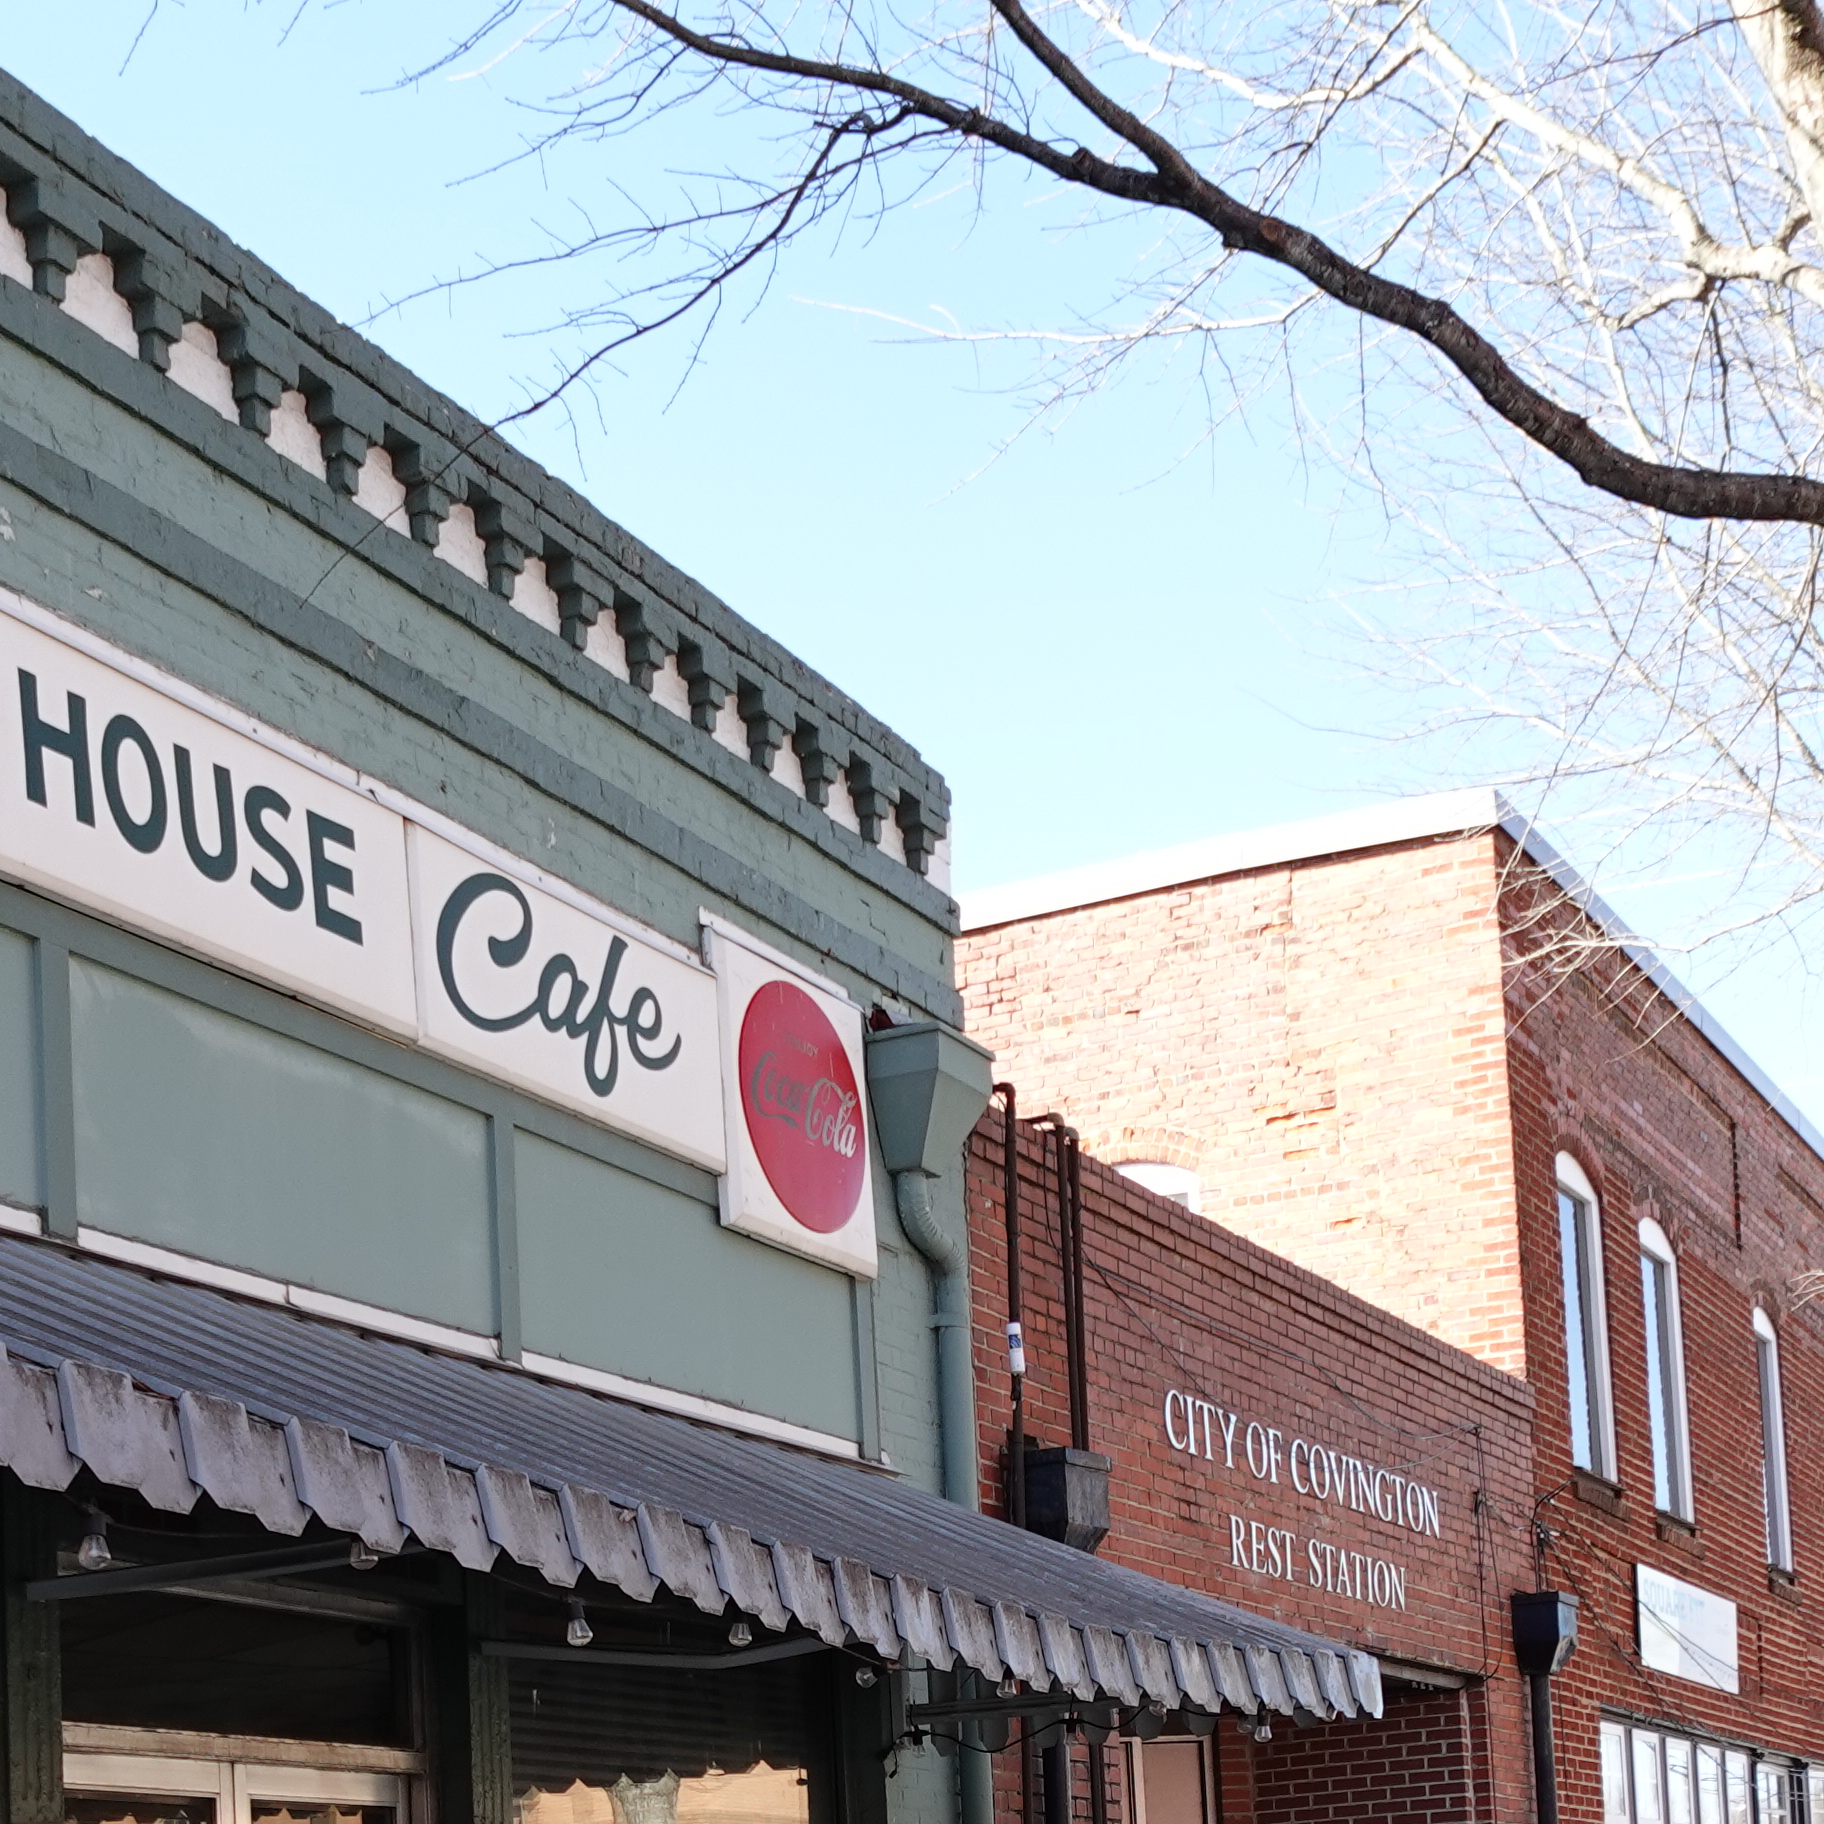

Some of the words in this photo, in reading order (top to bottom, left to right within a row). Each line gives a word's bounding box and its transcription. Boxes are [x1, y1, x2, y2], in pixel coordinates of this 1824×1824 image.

[16, 666, 364, 947] HOUSE
[435, 871, 682, 1098] Cafe
[1164, 1388, 1238, 1470] CITY
[1245, 1421, 1283, 1485] OF
[1290, 1438, 1441, 1540] COVINGTON
[1228, 1513, 1296, 1582] REST
[1307, 1538, 1406, 1613] STATION
